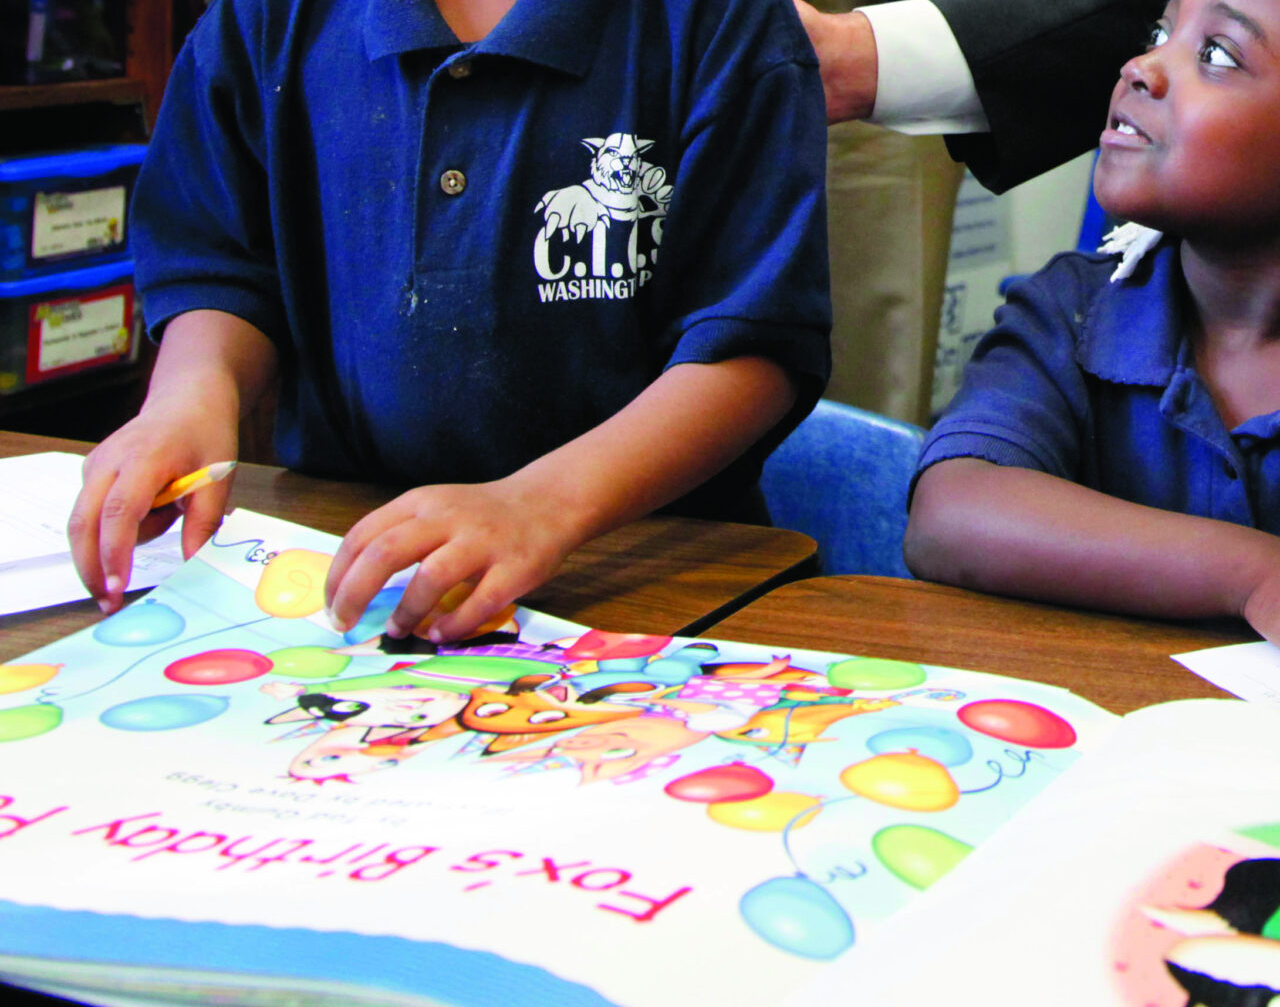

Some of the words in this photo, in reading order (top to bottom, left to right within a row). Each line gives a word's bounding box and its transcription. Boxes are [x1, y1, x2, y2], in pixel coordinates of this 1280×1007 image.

[536, 278, 638, 303] WASHINGT
[165, 770, 239, 792] Clegg
[71, 811, 440, 883] Birthday
[449, 849, 694, 924] Fox's
